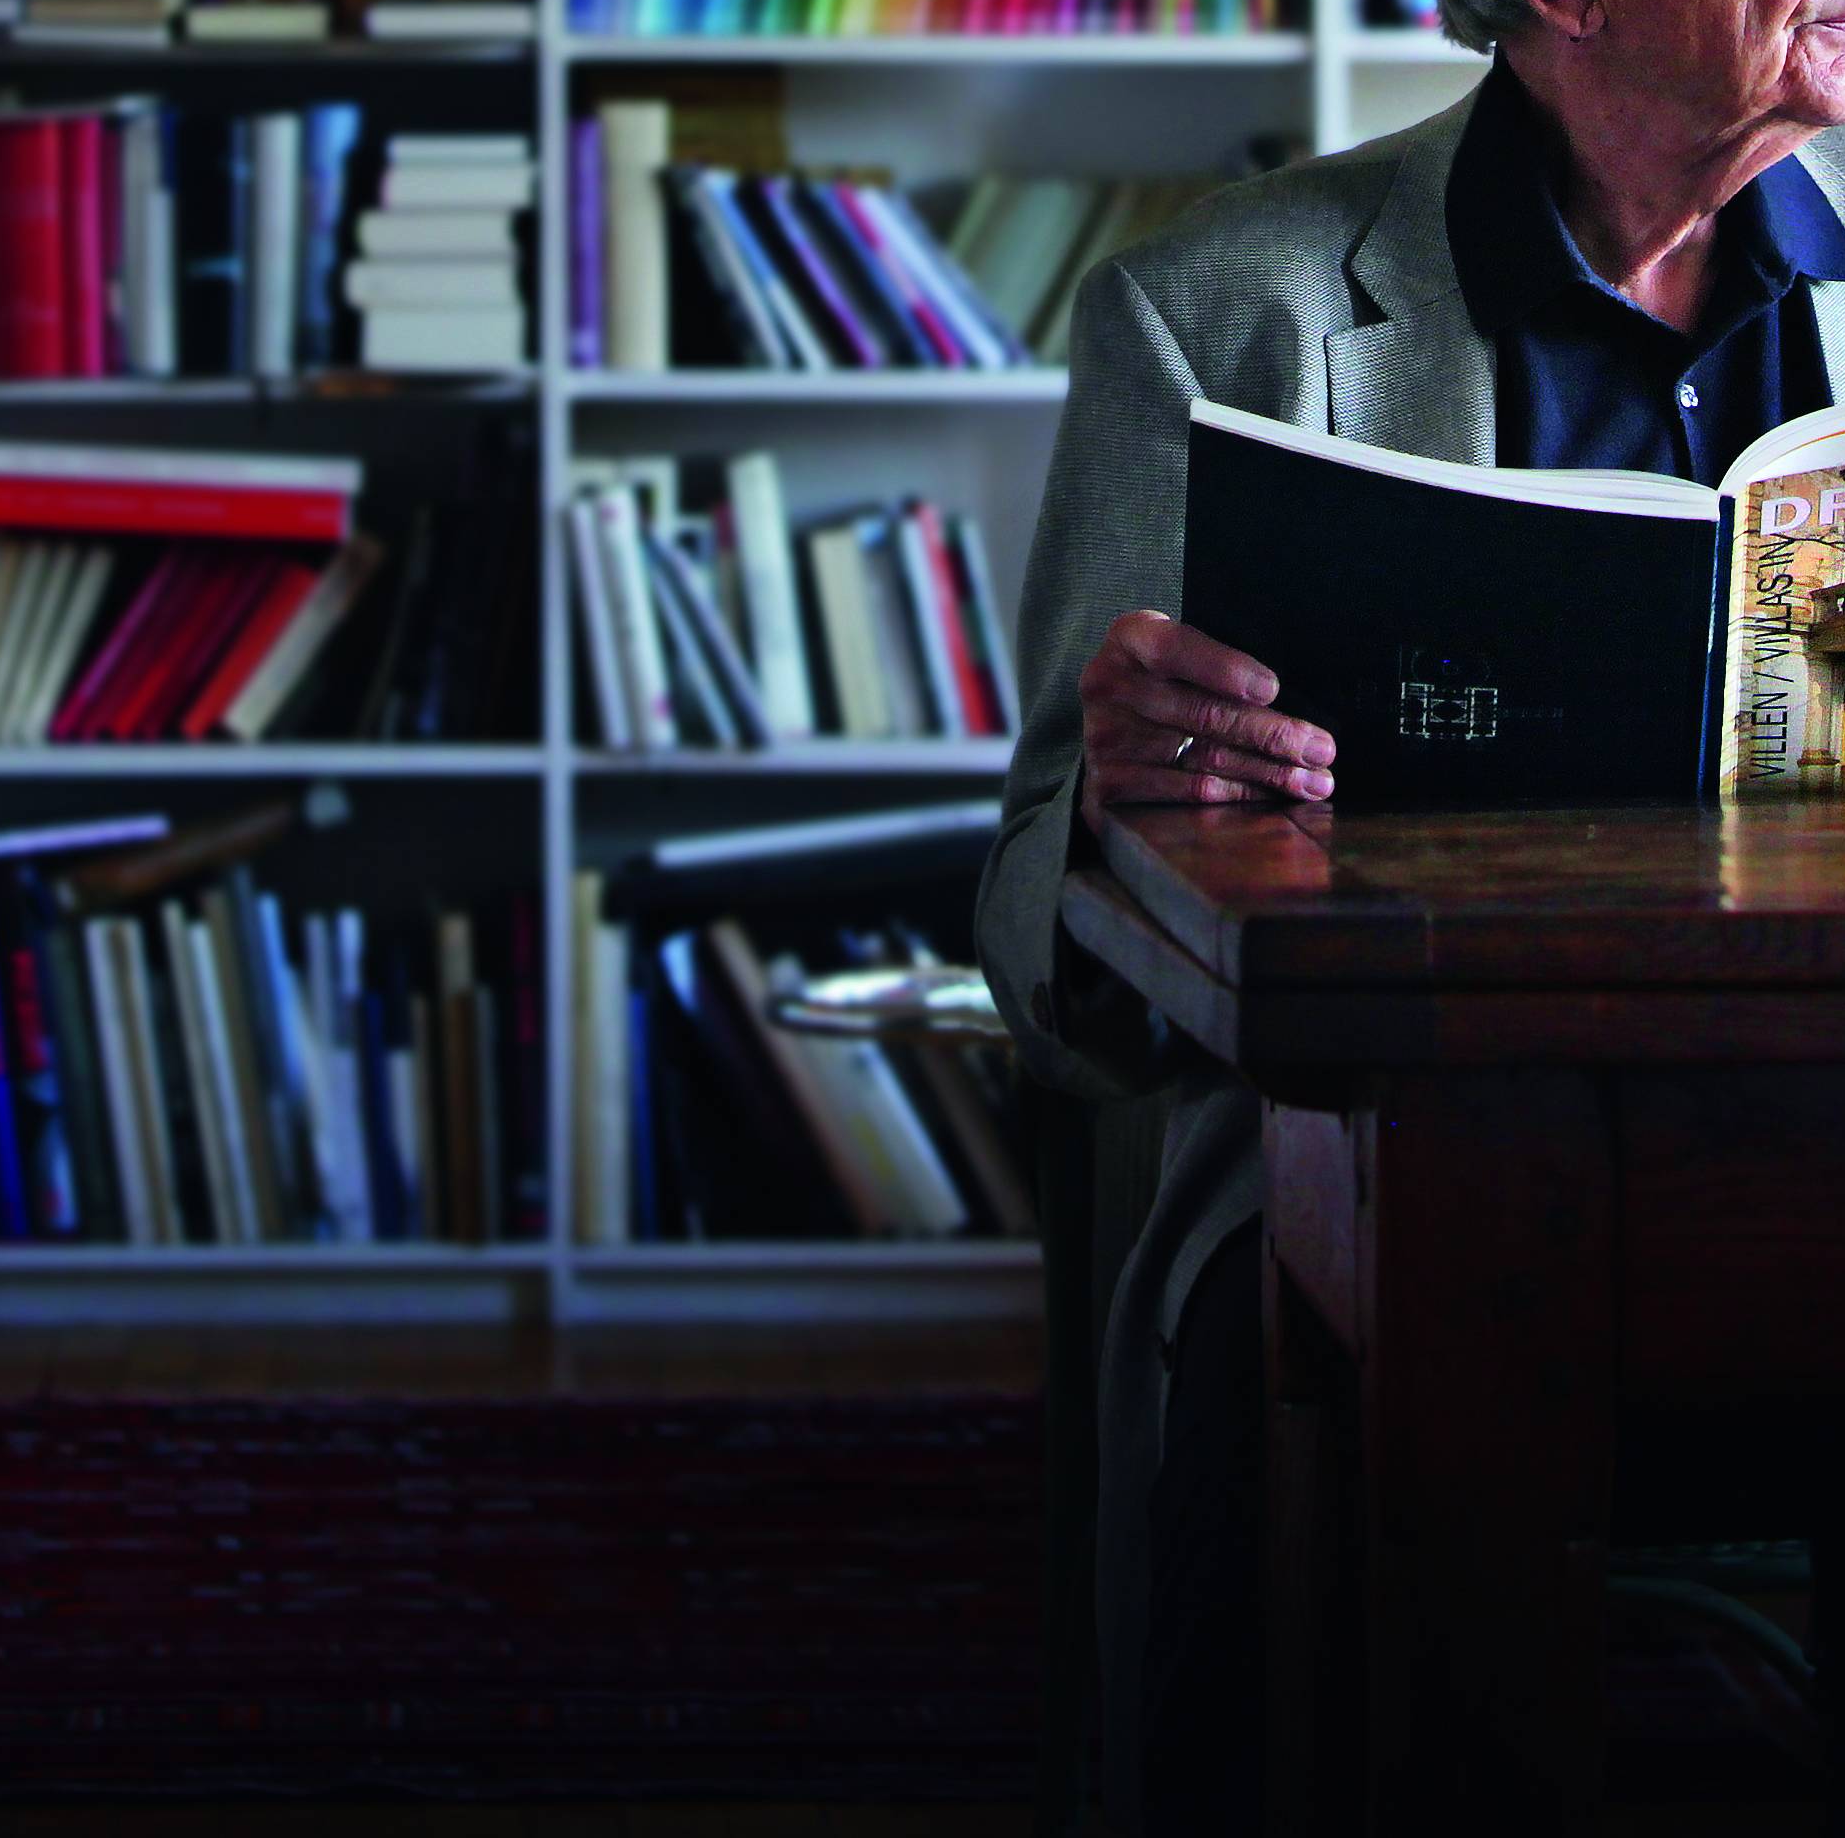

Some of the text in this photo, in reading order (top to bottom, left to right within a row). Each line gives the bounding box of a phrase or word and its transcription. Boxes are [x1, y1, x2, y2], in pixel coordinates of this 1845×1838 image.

[1749, 539, 1795, 779] VILLEN / VILLAS IN
